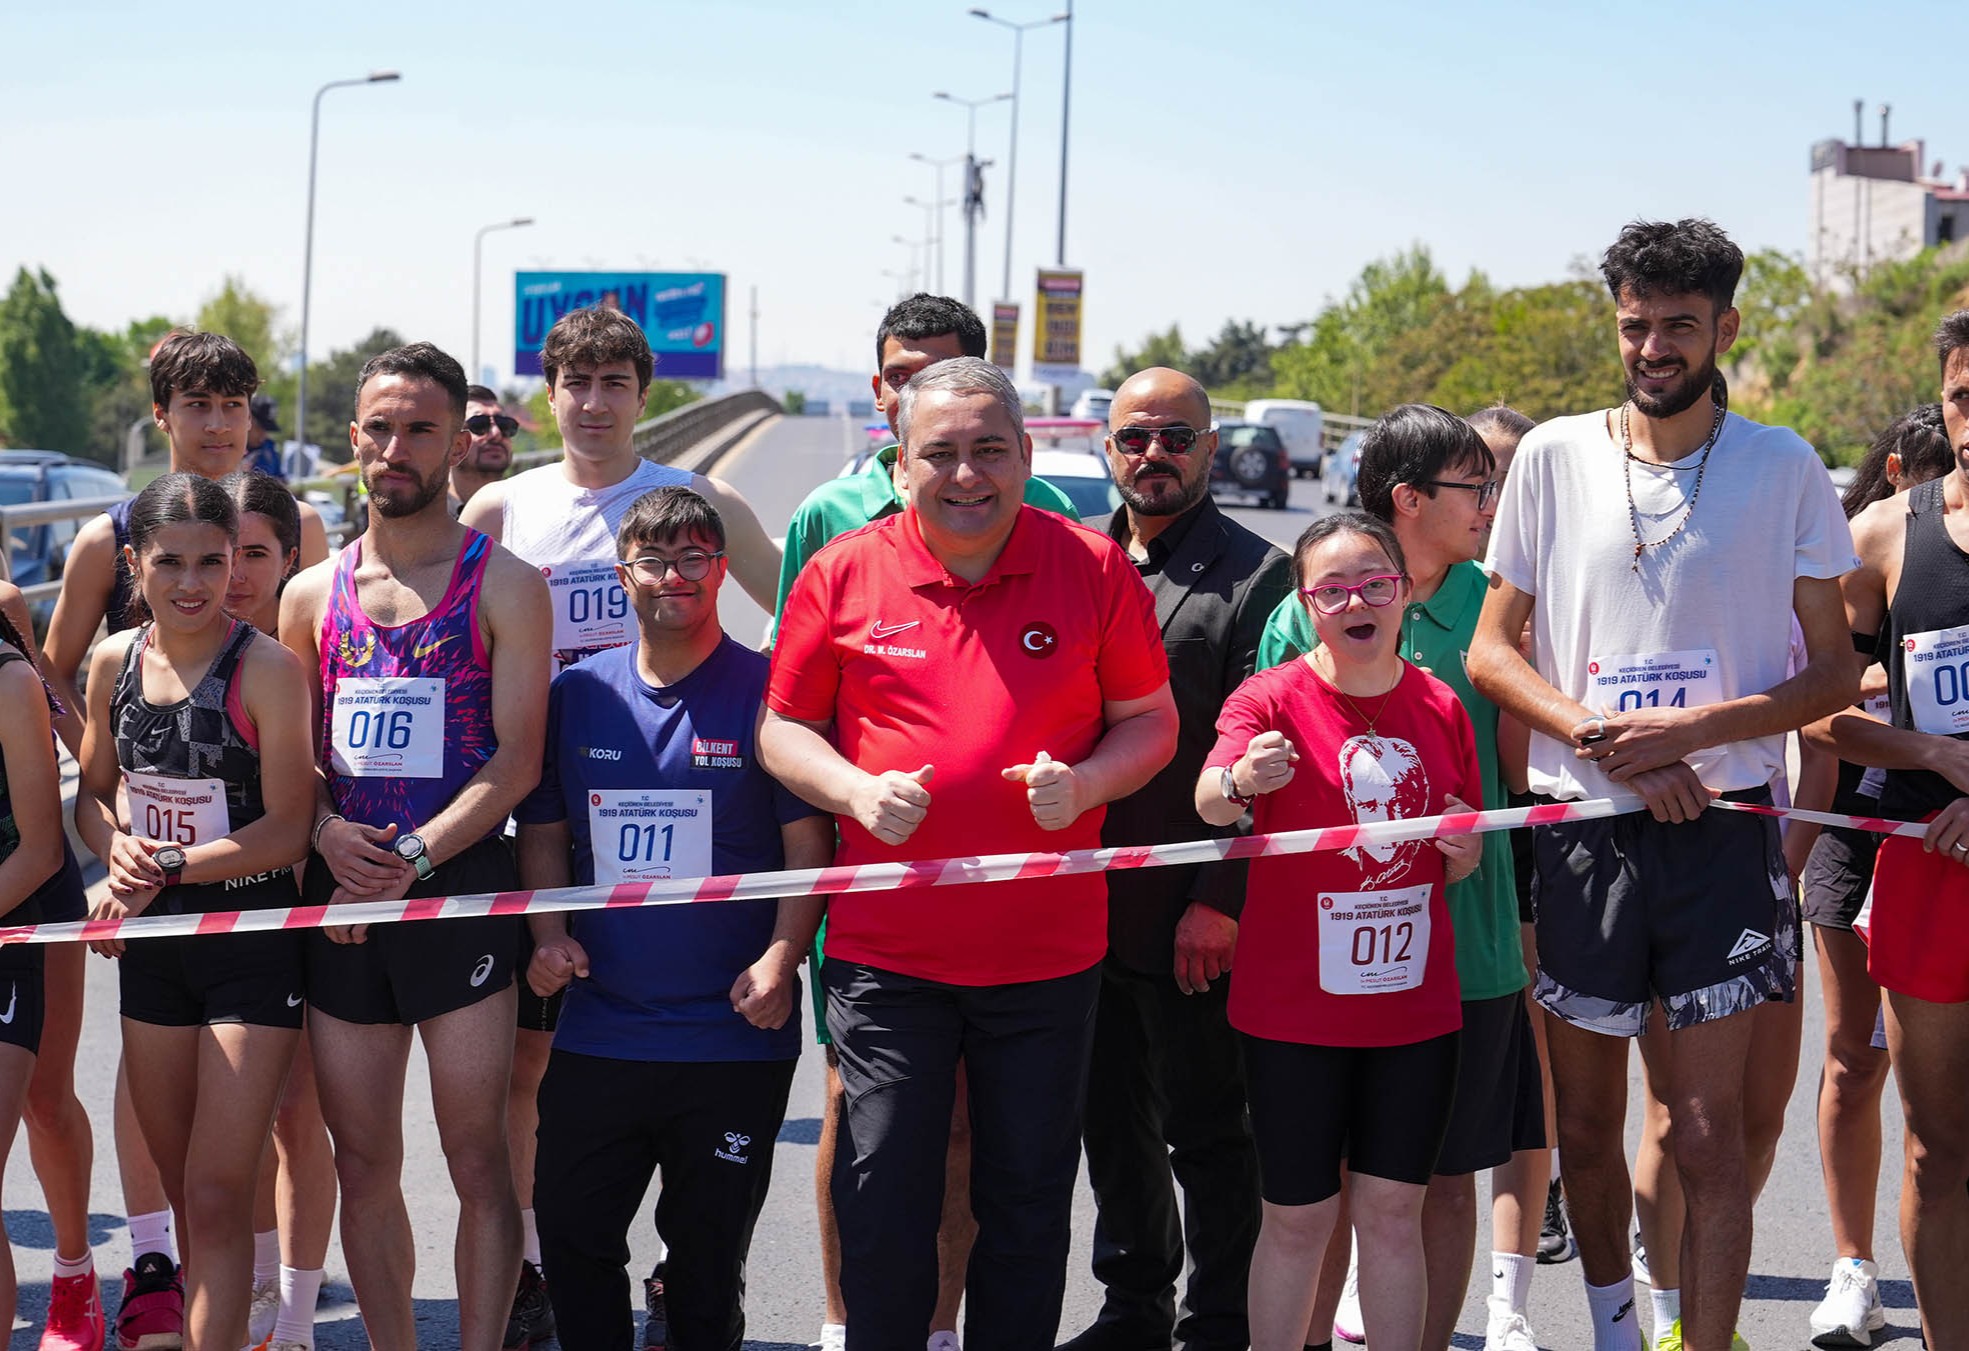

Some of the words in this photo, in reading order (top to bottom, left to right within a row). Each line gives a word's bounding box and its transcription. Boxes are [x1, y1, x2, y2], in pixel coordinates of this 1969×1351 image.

[550, 577, 569, 587] 1919
[570, 573, 606, 585] ATATÜRK
[570, 585, 628, 623] 019
[887, 645, 927, 659] ÖZARSLAN
[1914, 652, 1934, 662] 1919
[1597, 676, 1618, 686] 1919
[1620, 671, 1662, 684] ATATÜRK
[1665, 670, 1707, 681] KOŞUSU
[338, 696, 353, 705] 1919
[354, 695, 391, 705] ATATÜRK
[392, 696, 431, 706] KOŞUSU
[348, 711, 413, 749] 016
[589, 748, 622, 761] KORU
[696, 739, 734, 755] BİLKENT
[695, 756, 709, 766] YOL
[711, 756, 742, 768] KOŞUSU
[174, 795, 212, 806] KOŞUSU
[599, 808, 618, 817] 1919
[619, 807, 657, 818] ATATÜRK
[659, 808, 698, 818] KOŞUSU
[146, 804, 196, 846] 015
[618, 823, 674, 862] 011
[1330, 912, 1354, 921] 1919
[1355, 908, 1395, 920] ATATÜRK
[1351, 921, 1413, 966] 012
[1728, 953, 1751, 966] NIKE
[1753, 942, 1772, 956] TRAIL
[714, 1148, 748, 1164] hummel
